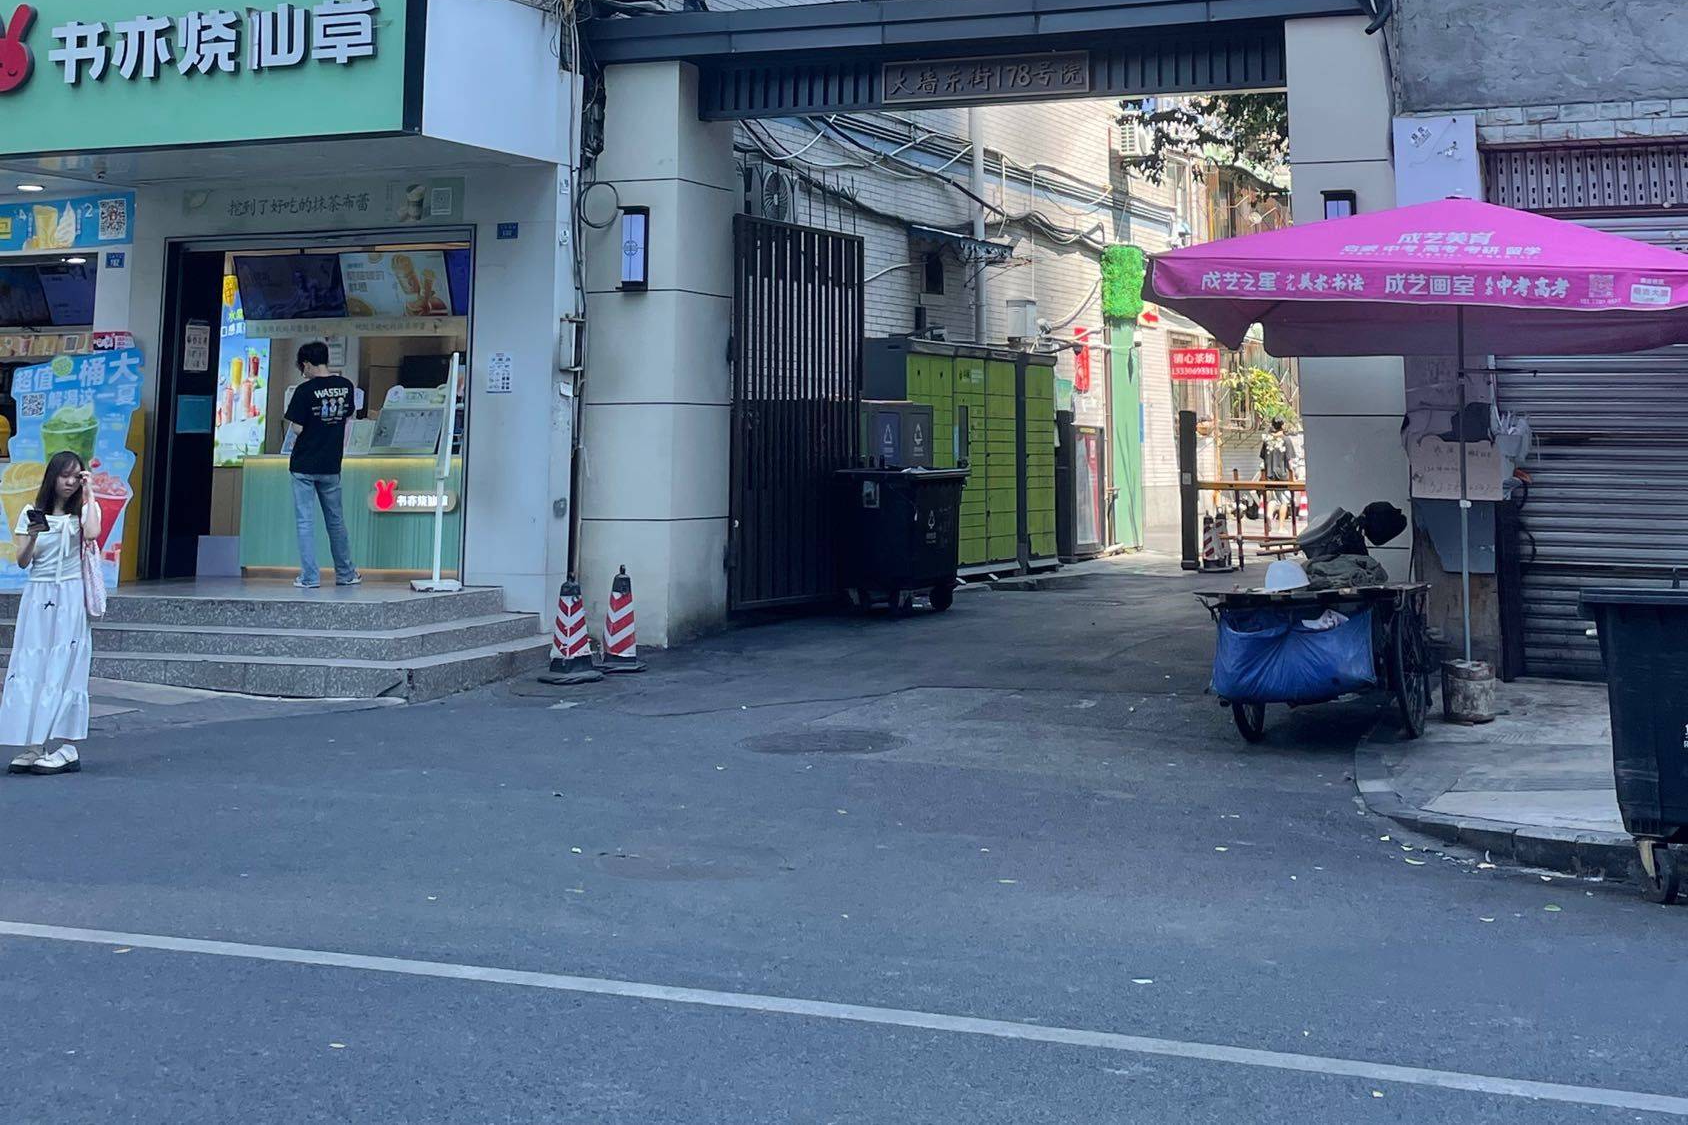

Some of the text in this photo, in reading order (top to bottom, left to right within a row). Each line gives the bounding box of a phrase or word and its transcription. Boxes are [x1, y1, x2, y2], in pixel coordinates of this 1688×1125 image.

[1201, 271, 1277, 291] 成艺之星
[1384, 273, 1474, 296] 成艺画室
[313, 387, 350, 399] WASSUP
